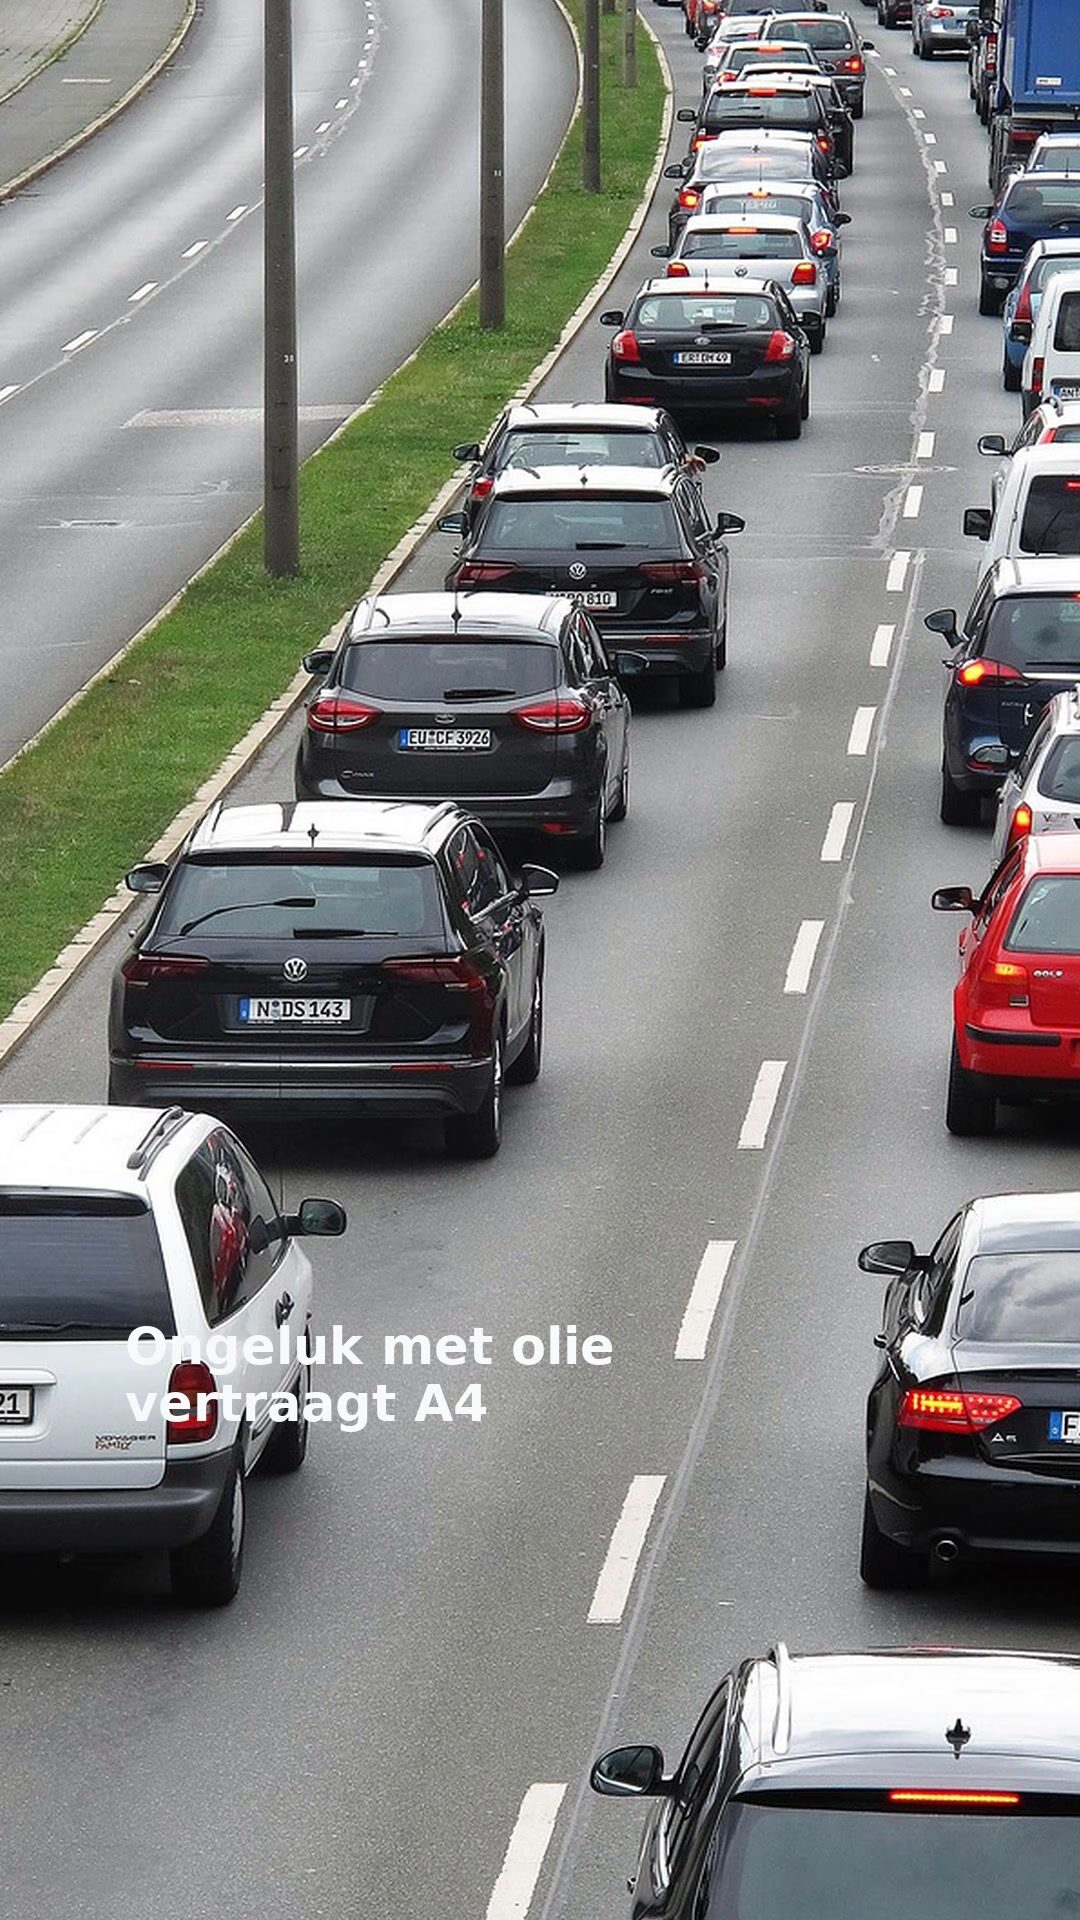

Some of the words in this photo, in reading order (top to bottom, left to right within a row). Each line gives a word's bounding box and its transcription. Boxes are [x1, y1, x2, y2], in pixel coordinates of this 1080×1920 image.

[586, 592, 611, 605] 810
[409, 730, 427, 745] EU
[436, 730, 455, 745] CF
[456, 730, 489, 745] 3926
[257, 1001, 270, 1018] N
[282, 1001, 306, 1018] DS
[308, 1001, 344, 1018] 143
